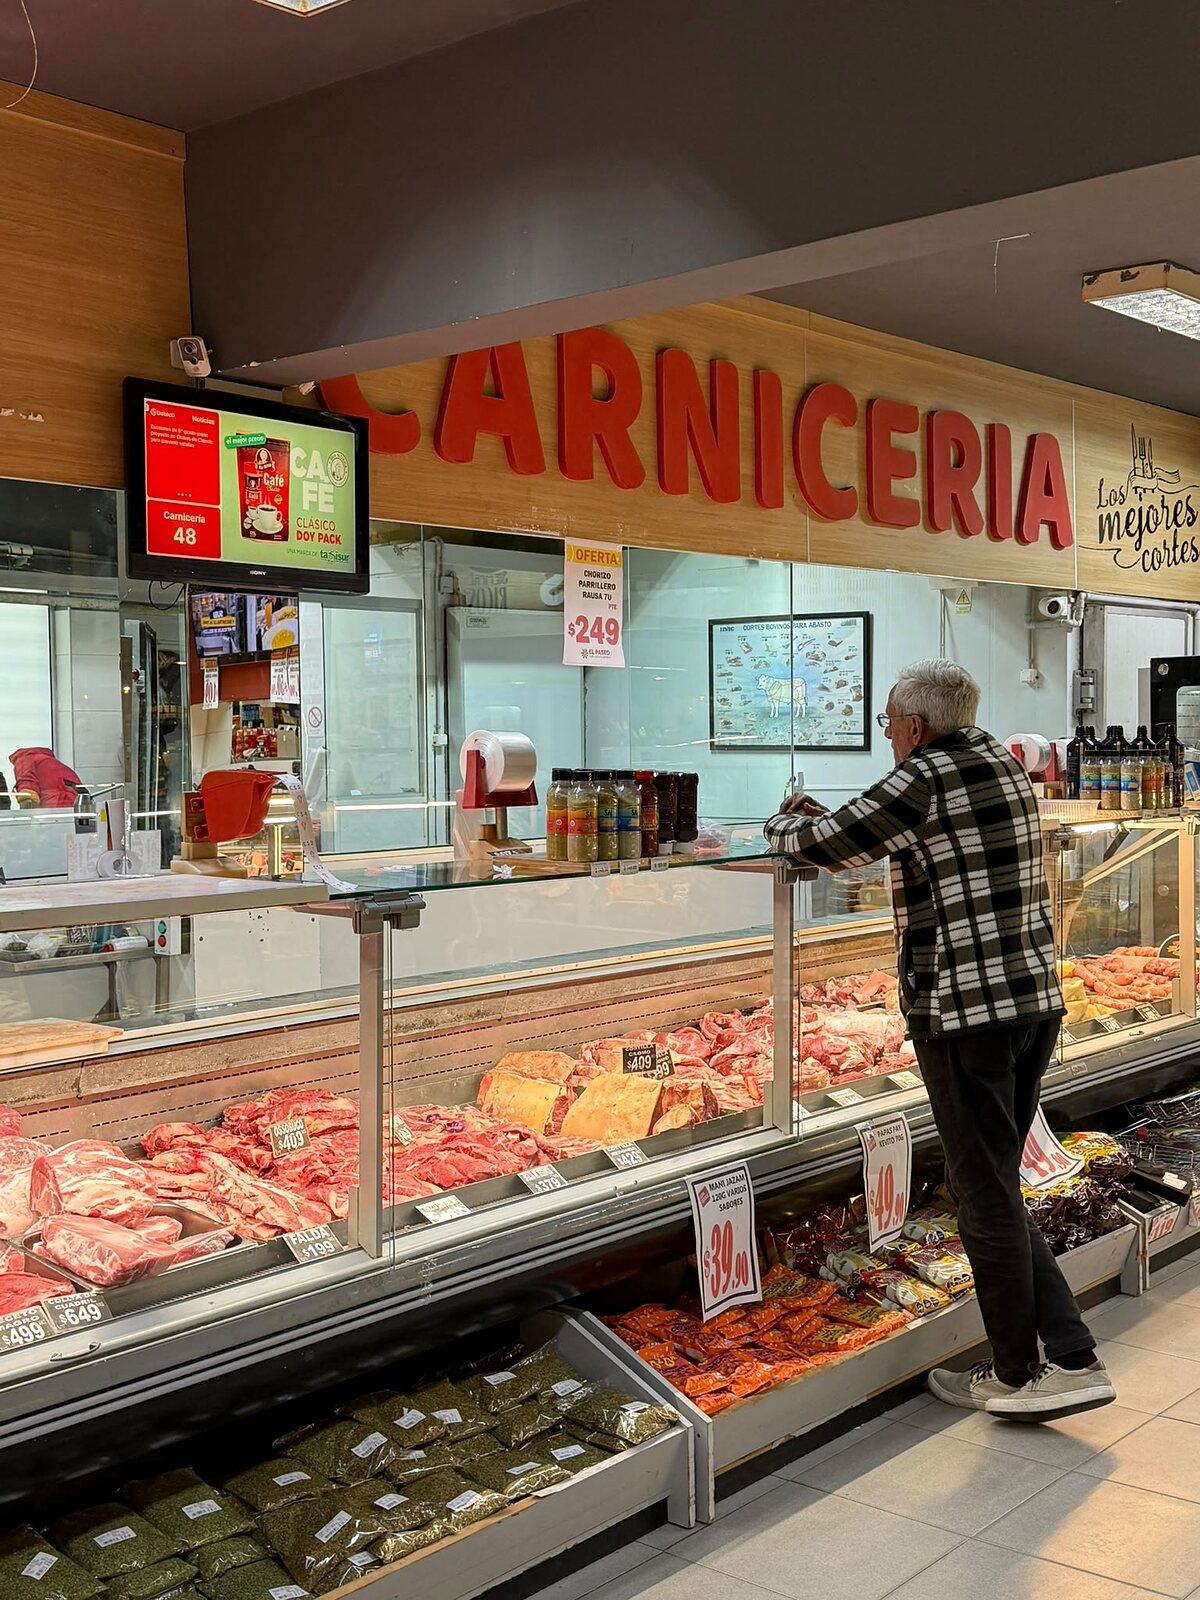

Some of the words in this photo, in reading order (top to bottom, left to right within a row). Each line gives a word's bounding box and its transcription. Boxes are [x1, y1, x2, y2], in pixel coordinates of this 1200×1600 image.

[192, 415, 216, 425] Noticias
[263, 472, 284, 488] Café
[1096, 477, 1126, 510] Los
[163, 510, 206, 524] Carnicería
[296, 516, 336, 532] CLÁSICO
[1098, 492, 1199, 551] mejores
[173, 526, 198, 546] 48
[296, 530, 316, 543] DOY
[317, 532, 342, 545] PACK
[576, 548, 618, 566] OFERTA
[1141, 528, 1200, 573] cortes
[584, 570, 612, 580] CHORIZO
[578, 580, 616, 591] PARRILLERO
[582, 592, 603, 600] RAUSA
[604, 592, 612, 600] 7U
[568, 615, 620, 646] $249
[742, 624, 765, 632] CORTES
[792, 622, 808, 630] PARA
[627, 1055, 652, 1072] $409
[274, 1119, 304, 1137] OSSOBUCO
[278, 1132, 304, 1150] $409
[708, 1180, 726, 1192] MANI
[726, 1174, 746, 1187] JAZAM
[712, 1188, 726, 1203] 120G
[726, 1184, 748, 1198] VARIOS
[869, 1163, 904, 1232] $49.90
[718, 1196, 744, 1213] SABORES
[290, 1226, 331, 1245] FALDA
[302, 1240, 336, 1258] $199
[703, 1220, 749, 1299] $39.90
[55, 1298, 97, 1310] CUADRIL
[58, 1303, 102, 1326] $649
[2, 1322, 46, 1346] $499
